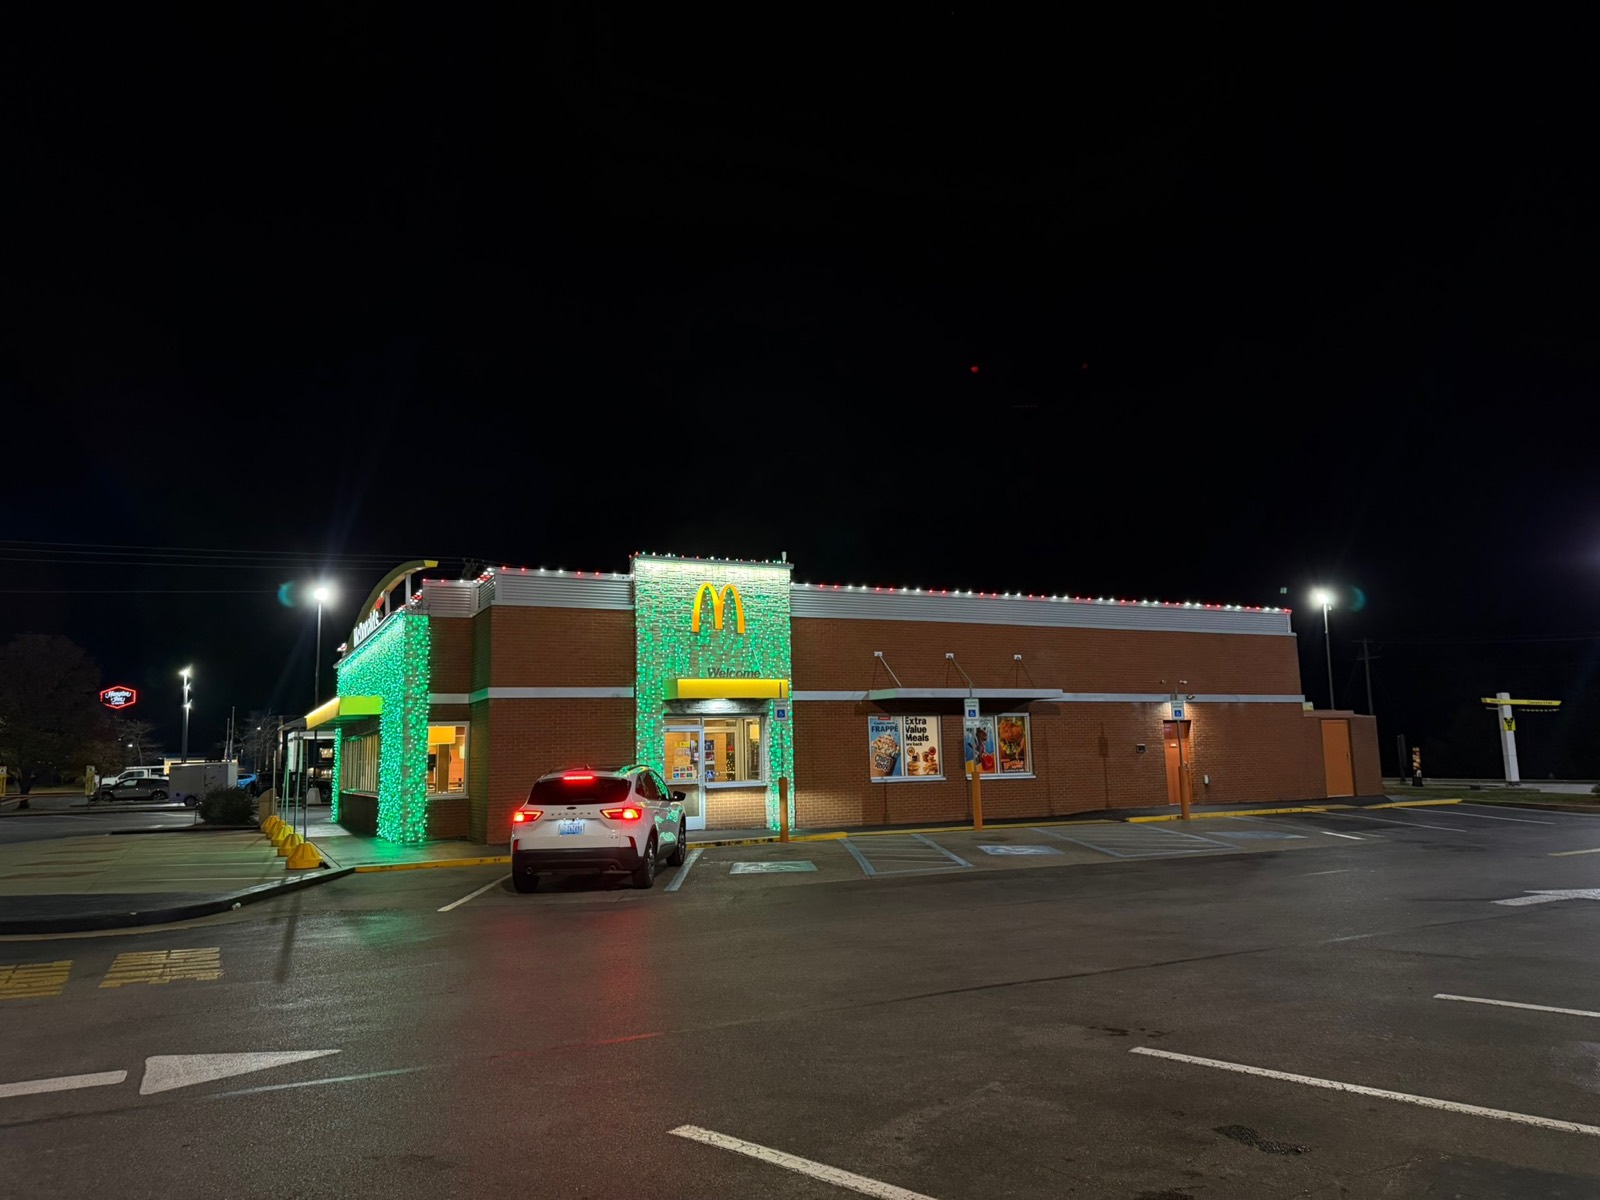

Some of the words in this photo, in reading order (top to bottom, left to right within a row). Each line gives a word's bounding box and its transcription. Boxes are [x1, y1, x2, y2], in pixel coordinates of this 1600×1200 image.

[707, 667, 760, 678] Welcome
[905, 716, 927, 725] Extra
[871, 723, 899, 733] FRAPPÉ
[905, 725, 927, 734] Value
[905, 734, 929, 742] Meals
